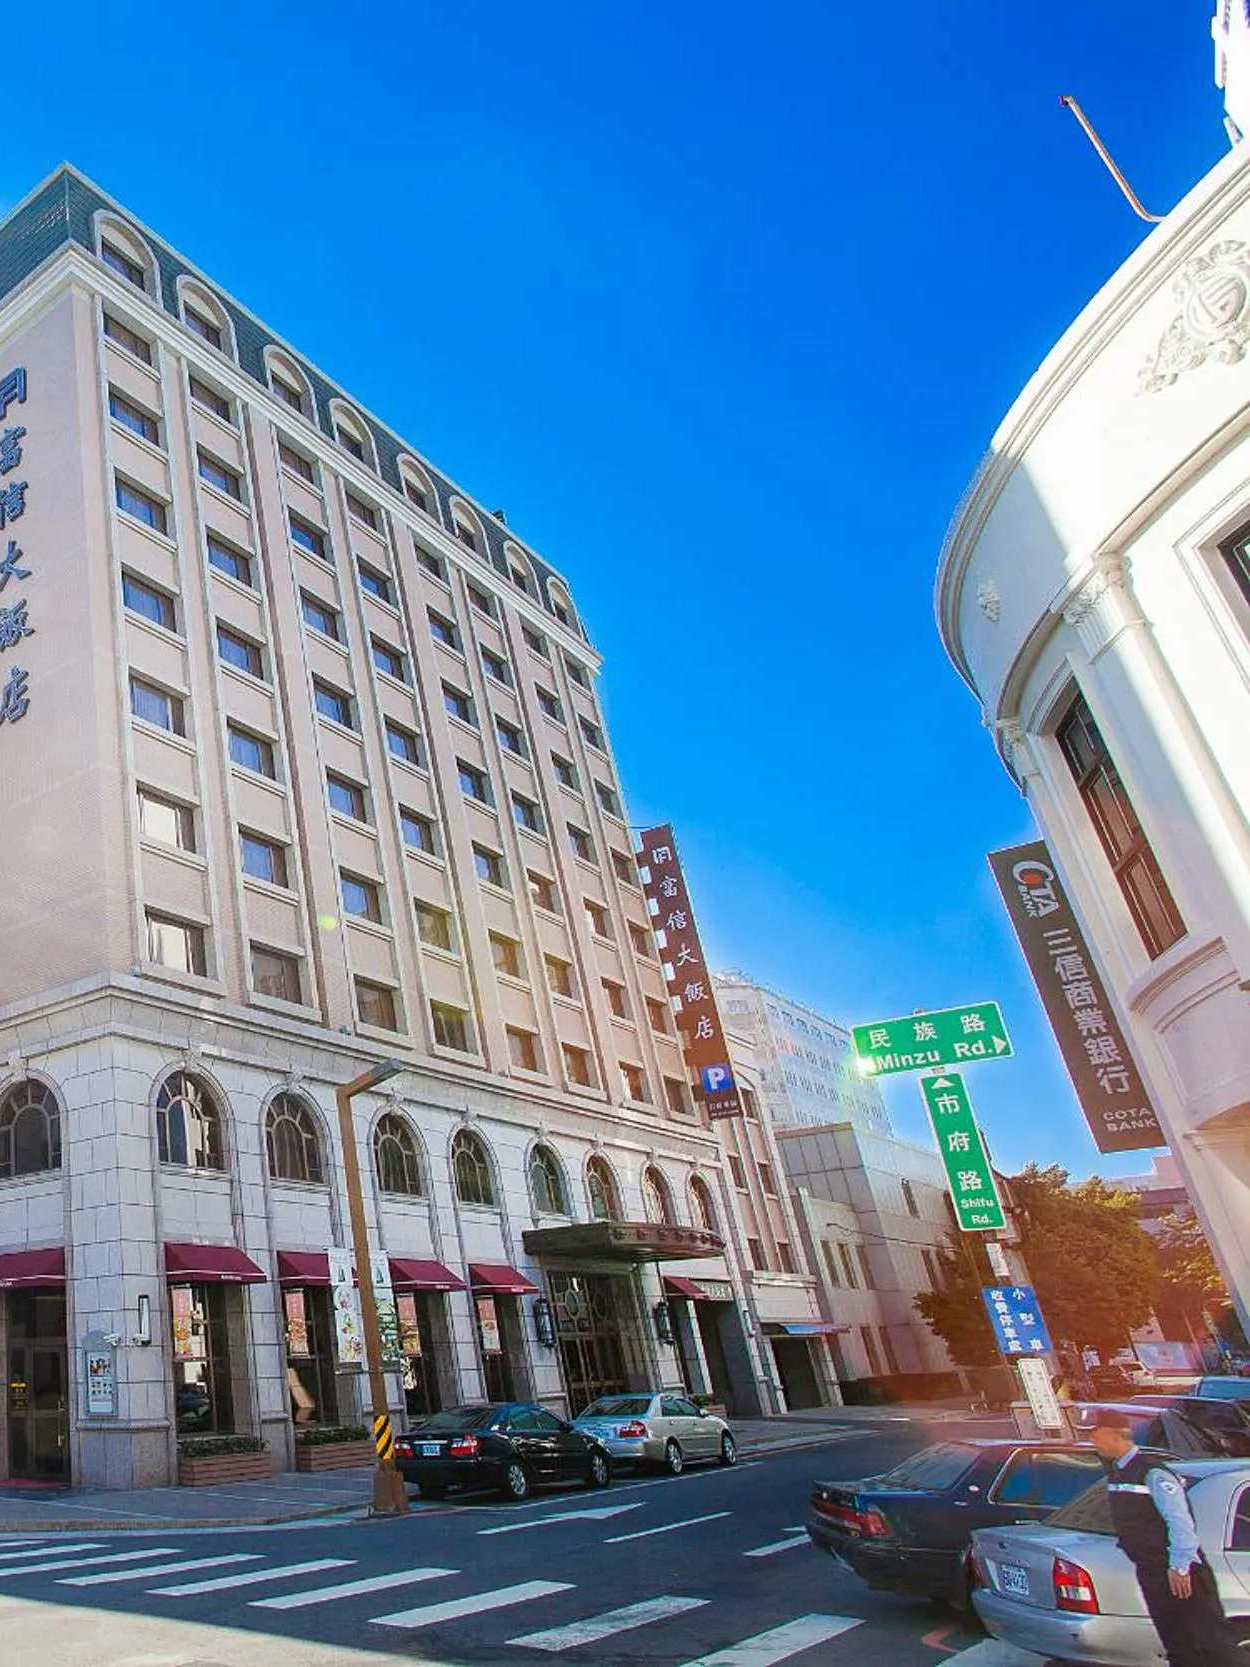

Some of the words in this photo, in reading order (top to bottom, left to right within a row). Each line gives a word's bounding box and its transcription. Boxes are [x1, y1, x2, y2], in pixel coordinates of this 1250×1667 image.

[1016, 884, 1039, 917] BANK
[659, 876, 715, 1040] 富信大飯店
[1043, 928, 1130, 1094] 三信商業銀行
[868, 1013, 986, 1050] 民族路
[875, 1048, 941, 1071] Minzu
[953, 1039, 993, 1058] Rd.
[707, 1067, 726, 1090] P
[1103, 1106, 1152, 1122] COTA
[1105, 1116, 1157, 1133] BANK
[935, 1093, 983, 1191] 市府路
[960, 1197, 995, 1210] Shifu
[971, 1214, 993, 1225] Rd.
[1012, 1288, 1044, 1351] 小型車
